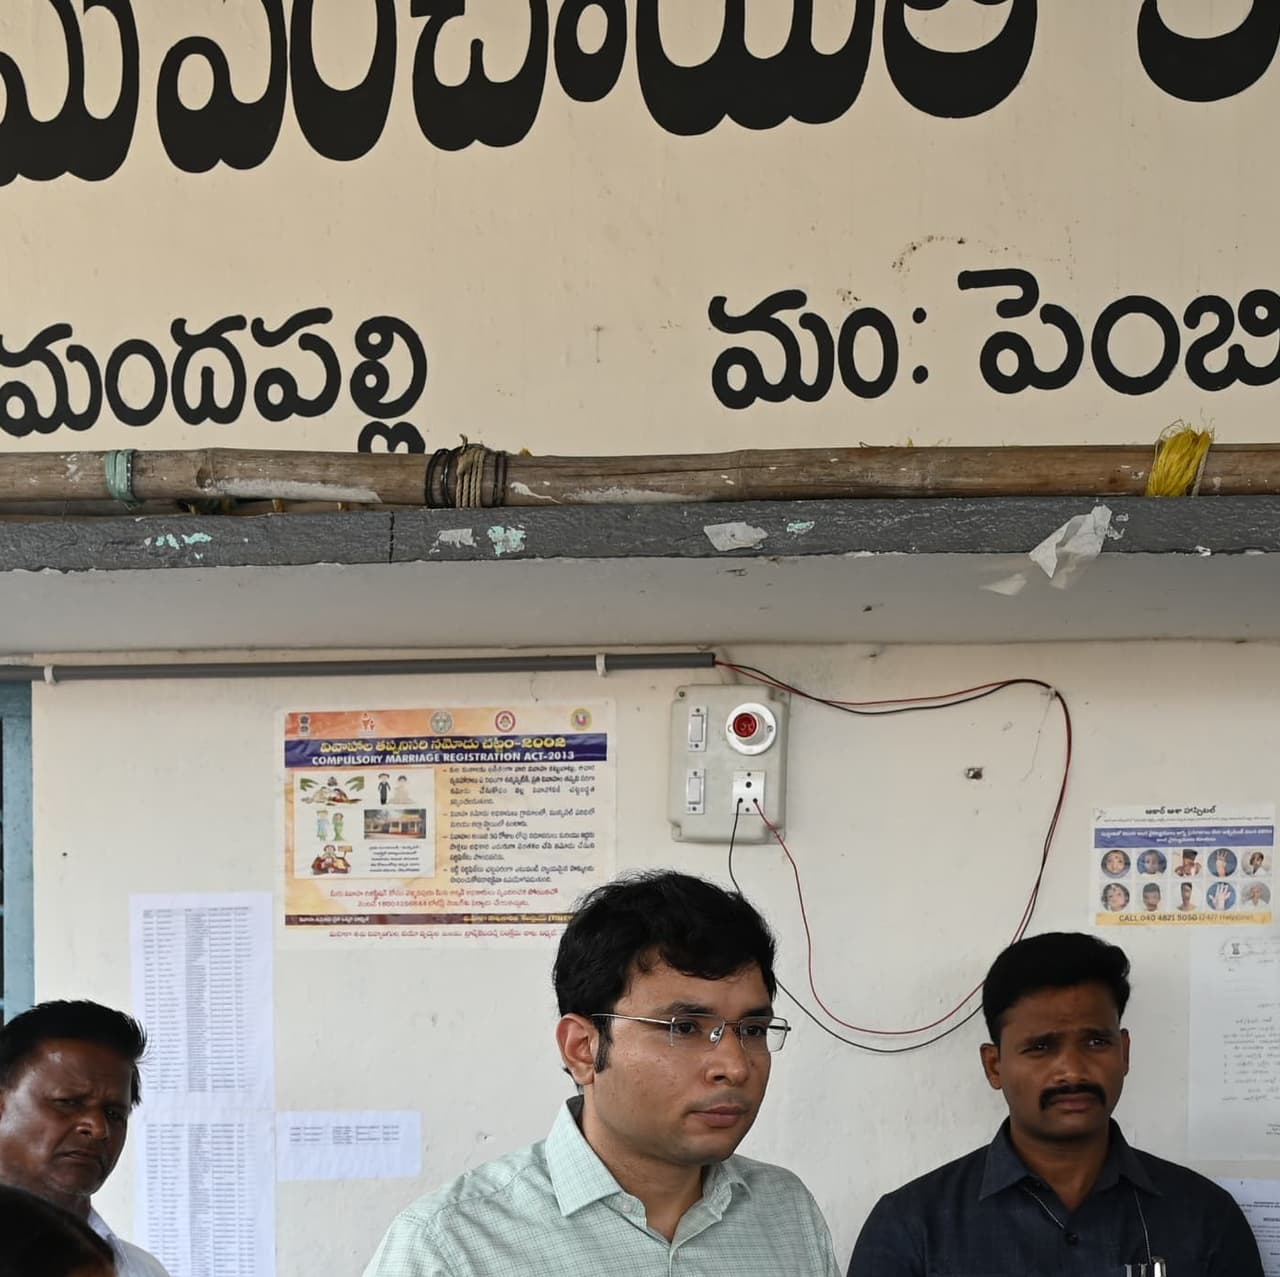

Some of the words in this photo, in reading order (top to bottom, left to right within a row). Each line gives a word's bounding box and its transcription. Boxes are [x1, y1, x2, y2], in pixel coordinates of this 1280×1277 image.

[707, 289, 928, 410] మం:
[312, 754, 382, 766] COMPULSORY
[385, 753, 440, 763] MARRIAGE
[443, 750, 521, 762] REGISTRATION
[524, 750, 575, 761] ACT-2013
[1119, 914, 1141, 922] CALL
